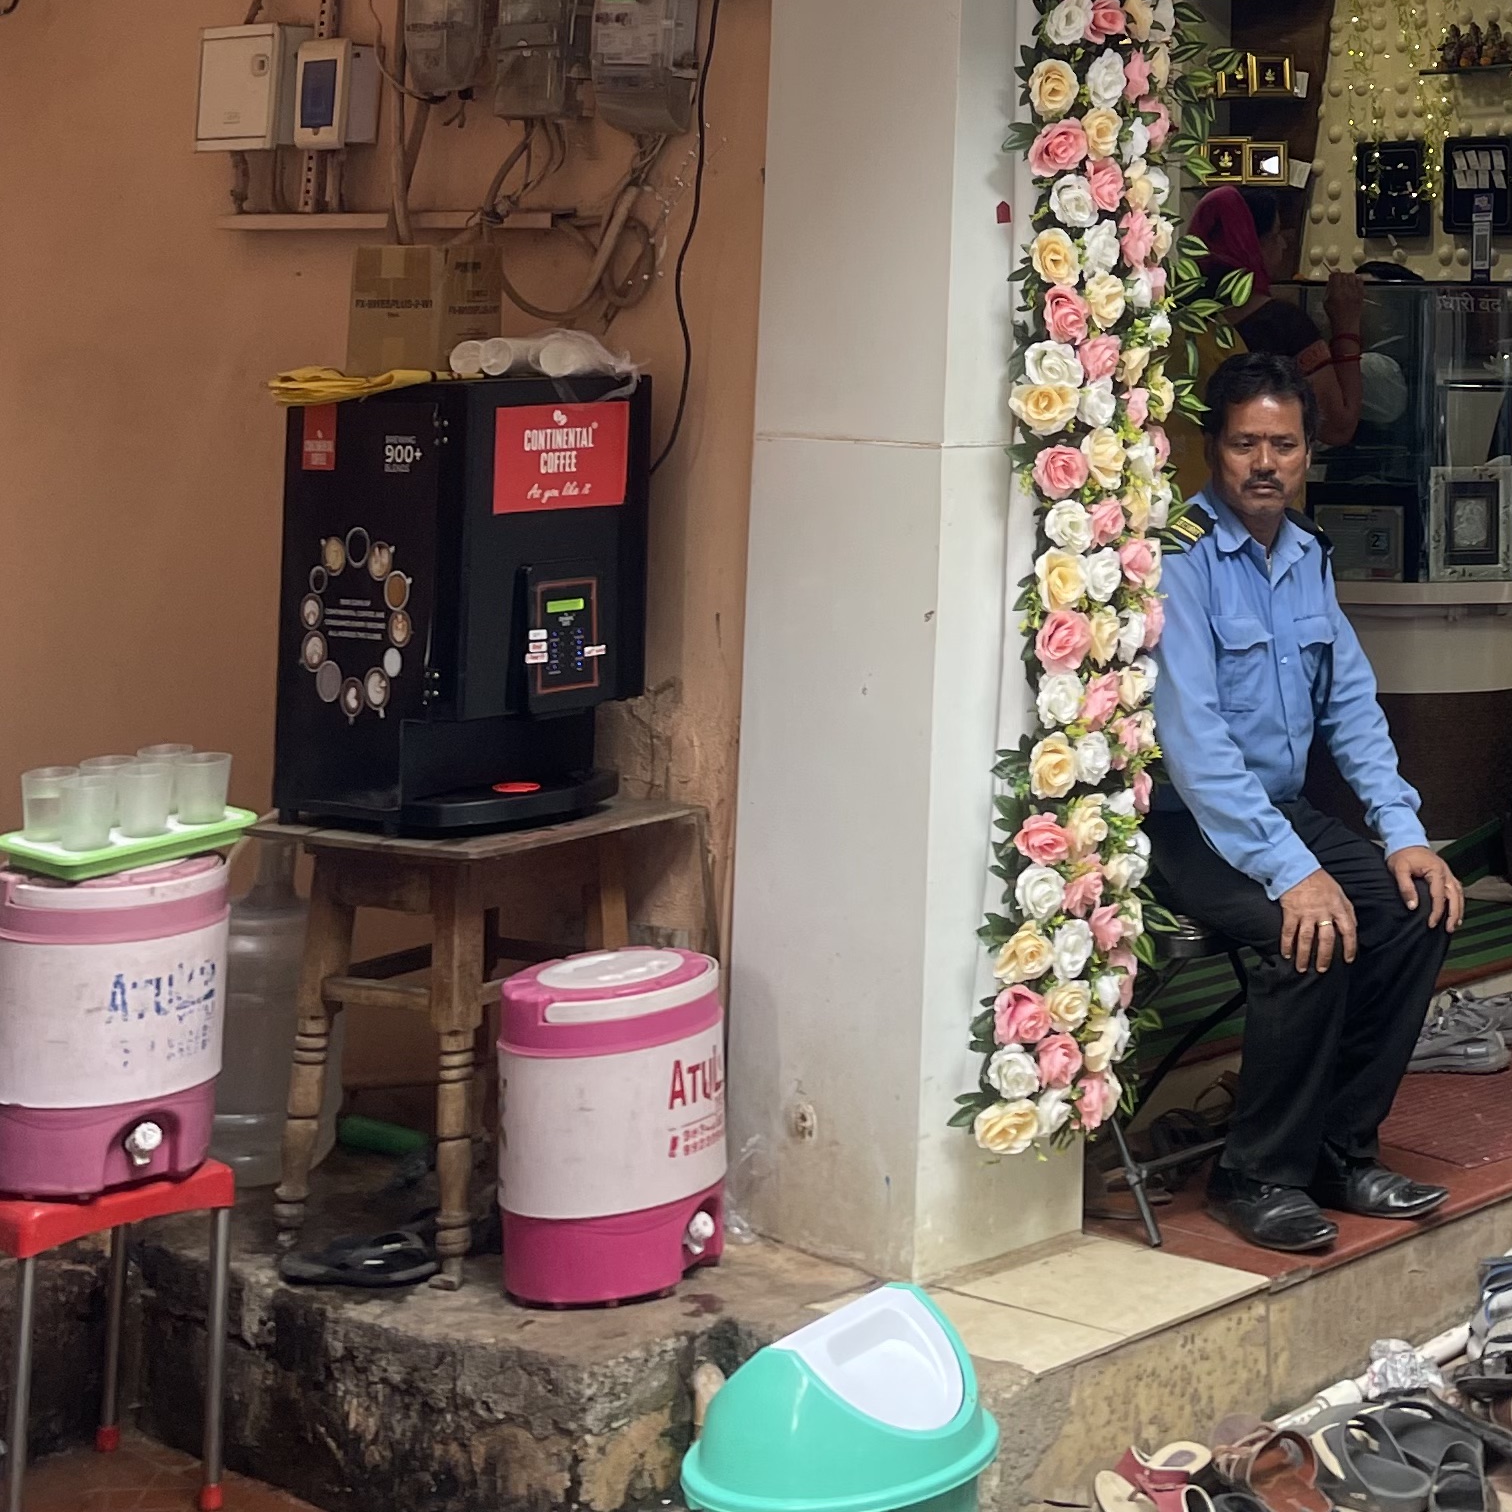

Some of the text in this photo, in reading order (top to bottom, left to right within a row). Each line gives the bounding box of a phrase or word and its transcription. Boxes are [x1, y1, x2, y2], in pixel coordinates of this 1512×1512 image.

[523, 426, 595, 451] CONTINENTAL
[384, 444, 423, 463] 900+
[540, 450, 577, 474] COFFEE
